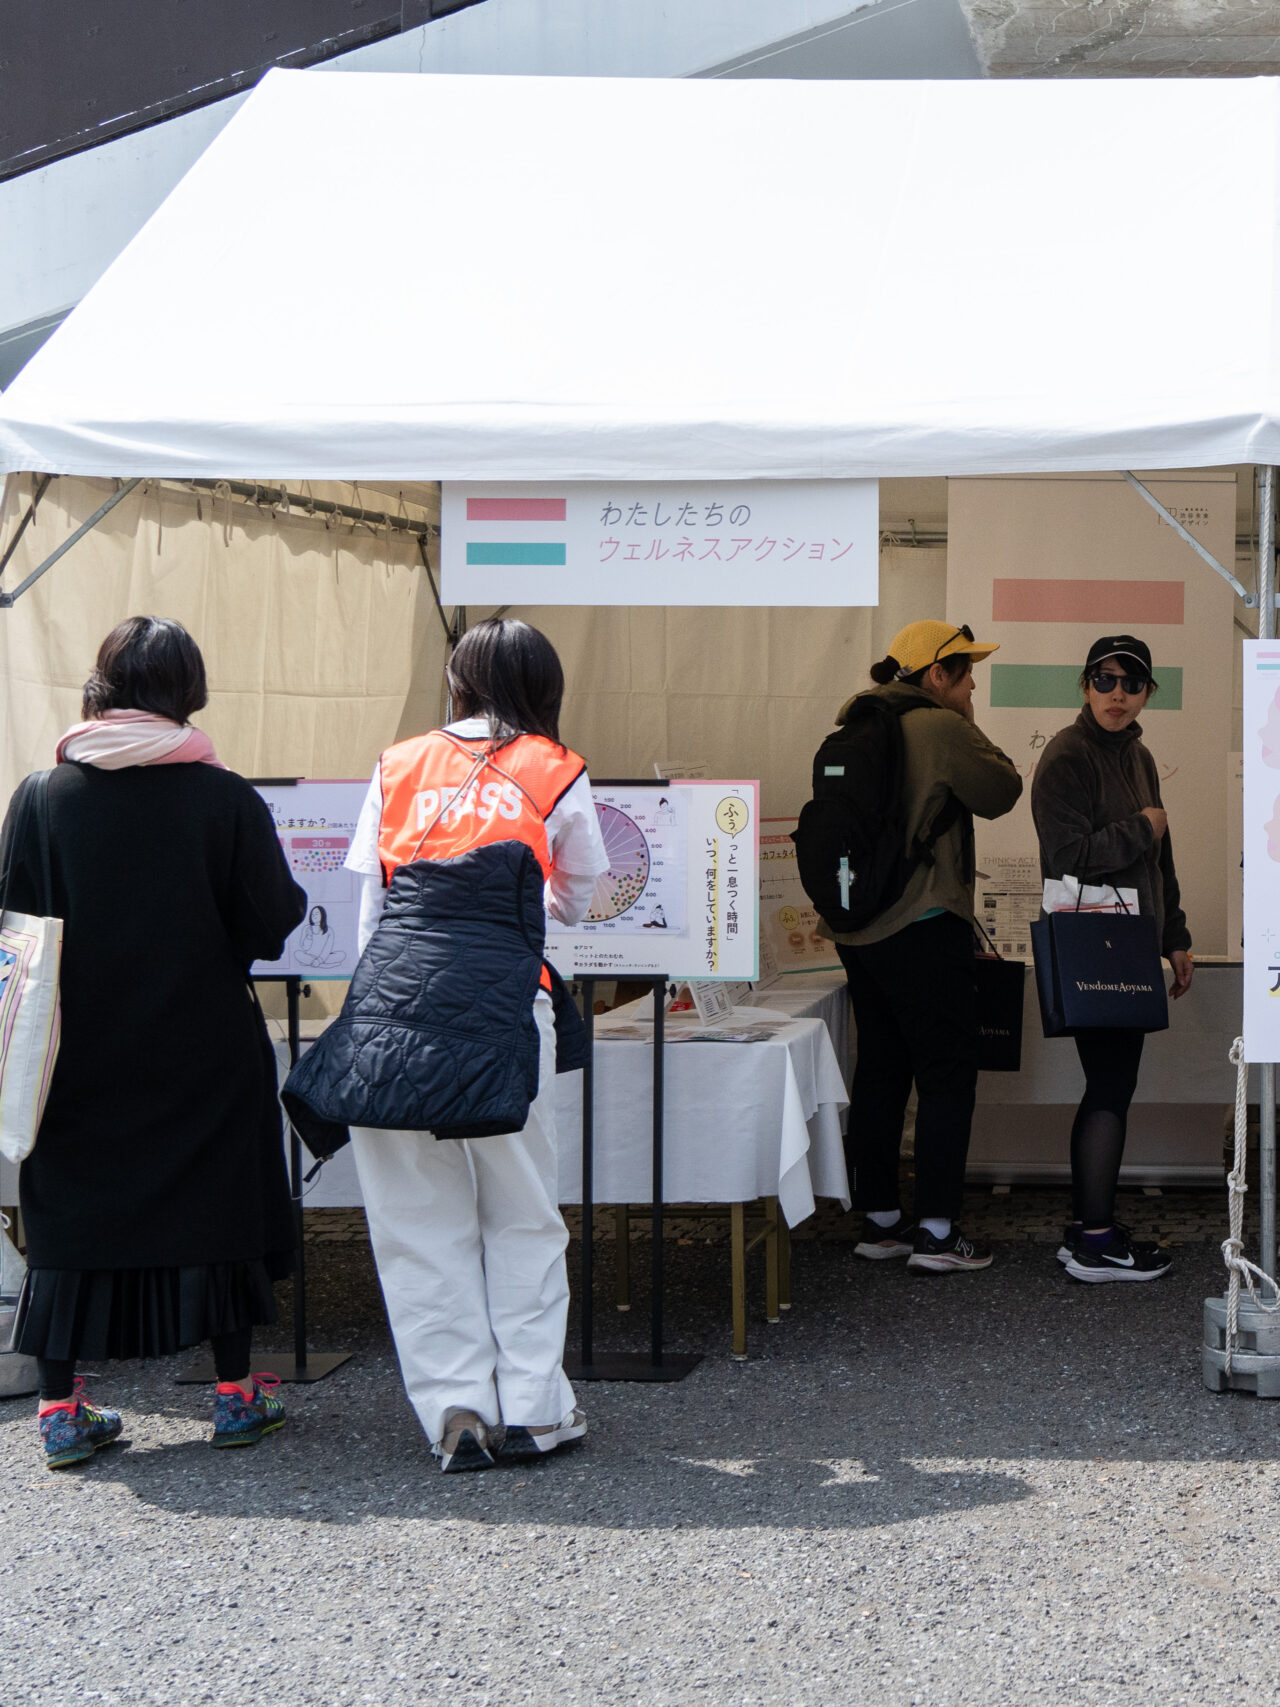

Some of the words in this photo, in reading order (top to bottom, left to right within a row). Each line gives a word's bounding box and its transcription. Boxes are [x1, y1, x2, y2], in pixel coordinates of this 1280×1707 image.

[600, 501, 752, 528] わたしたちの
[598, 536, 855, 563] ウェルネスアクション
[705, 837, 718, 972] いつ、何をしていますか？
